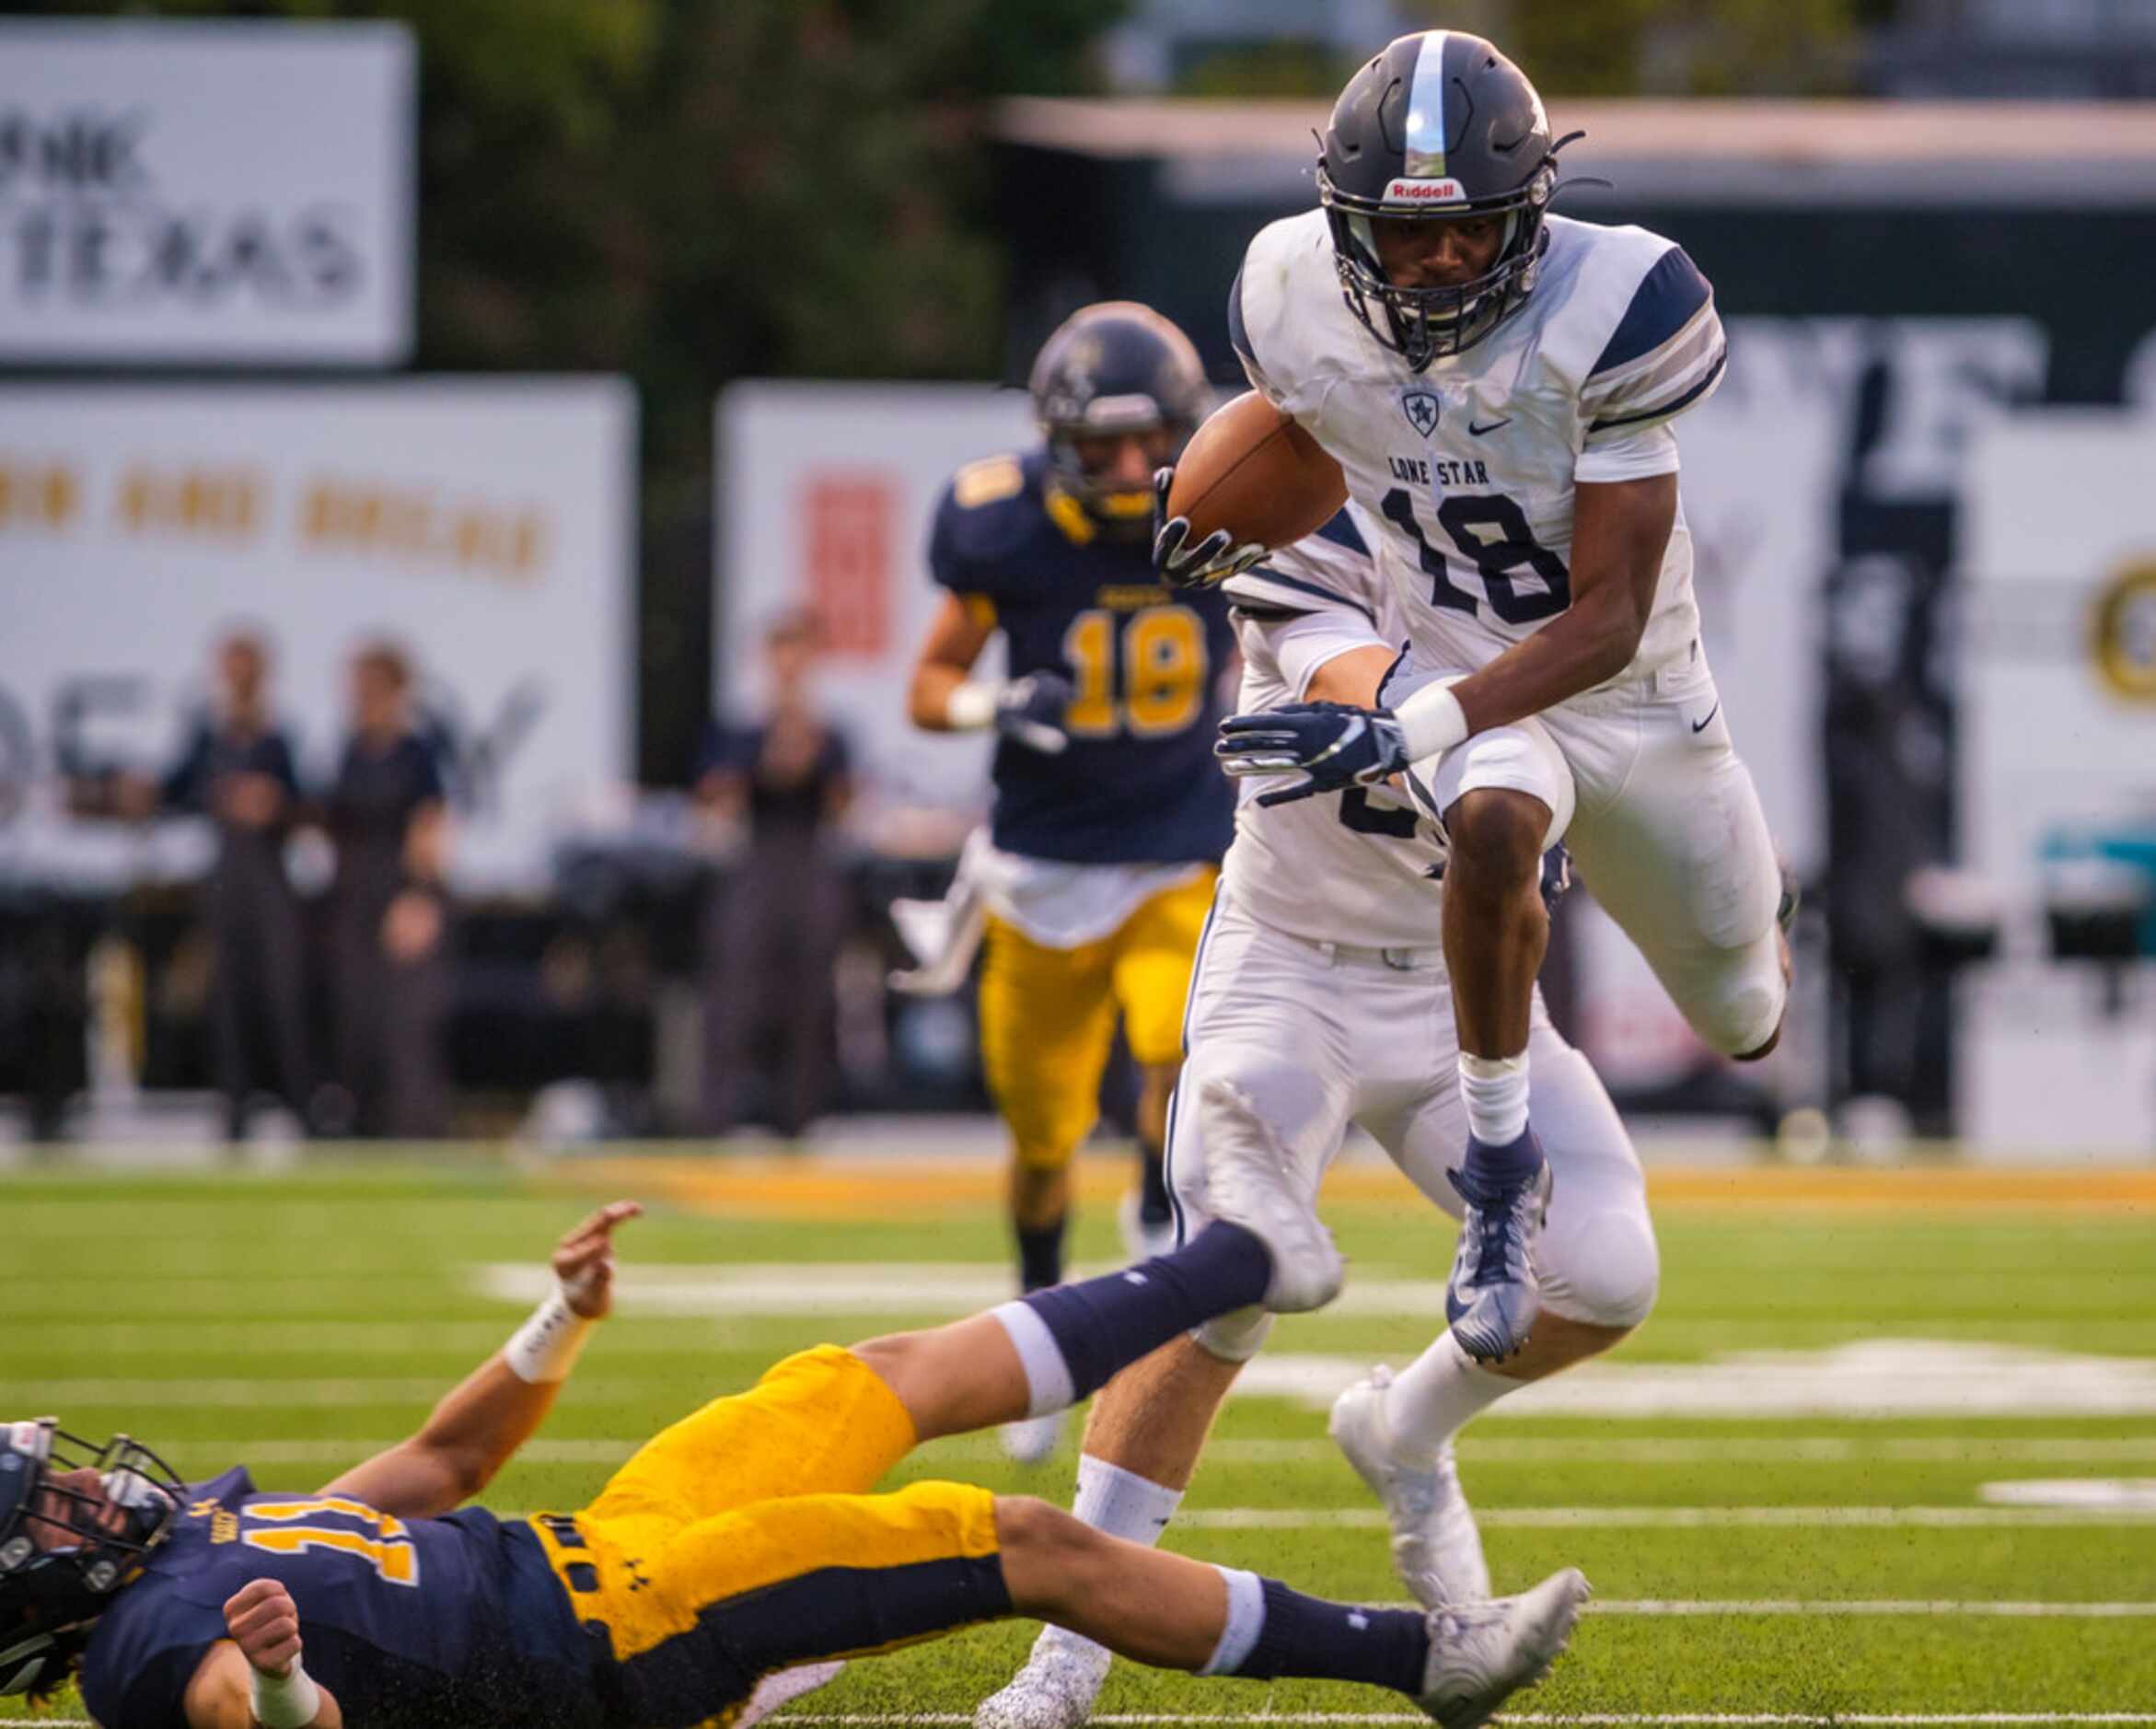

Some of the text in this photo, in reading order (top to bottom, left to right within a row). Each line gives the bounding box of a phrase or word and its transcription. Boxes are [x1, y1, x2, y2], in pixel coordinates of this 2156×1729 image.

[1392, 183, 1455, 198] Riddell
[18, 212, 359, 300] TEXAS
[1388, 457, 1489, 485] LONE STAR
[1381, 488, 1571, 625] 18
[241, 1497, 419, 1586] 11
